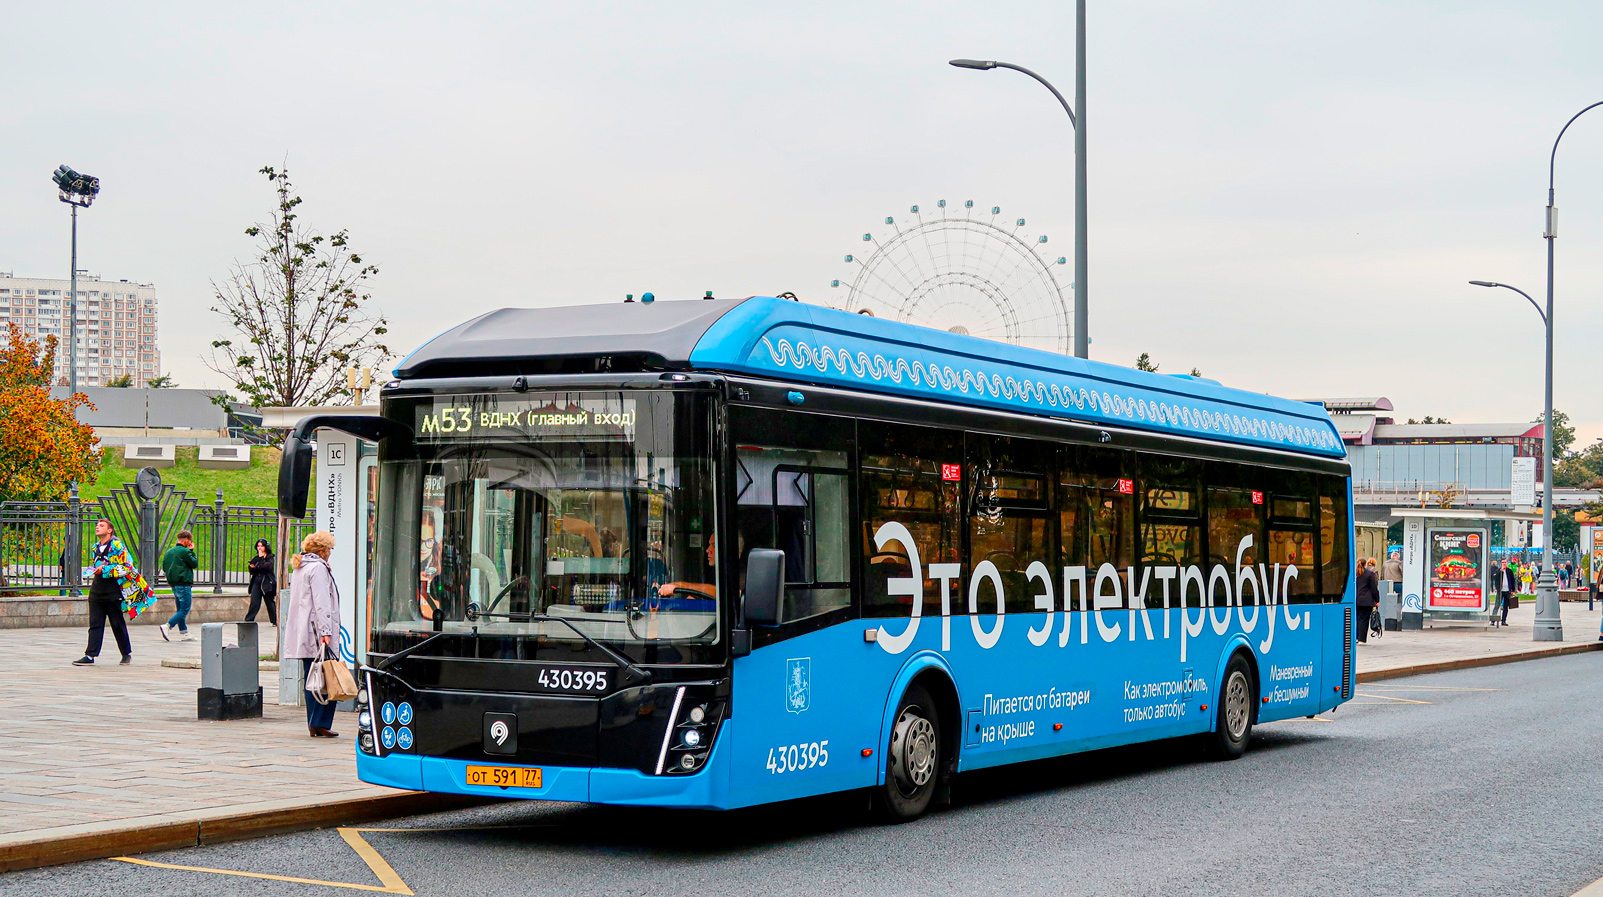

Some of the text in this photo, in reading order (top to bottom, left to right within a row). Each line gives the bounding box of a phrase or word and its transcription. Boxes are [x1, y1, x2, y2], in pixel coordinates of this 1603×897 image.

[480, 411, 521, 428] ВДНХ
[527, 410, 588, 427] (главный
[594, 408, 636, 427] вход)
[328, 473, 336, 514] «ВДНХ»
[873, 520, 1311, 663] Это электробус.
[538, 669, 607, 691] 430395
[1269, 661, 1313, 683] Маневренный
[1124, 673, 1208, 700] Как электромобиль,
[1268, 682, 1309, 705] и бесшумный
[983, 687, 1090, 717] Питается от батареи
[1124, 698, 1186, 723] только автобус
[981, 720, 1035, 746] на крыше
[766, 740, 829, 775] 430395
[493, 768, 517, 784] 591
[524, 769, 537, 781] 77
